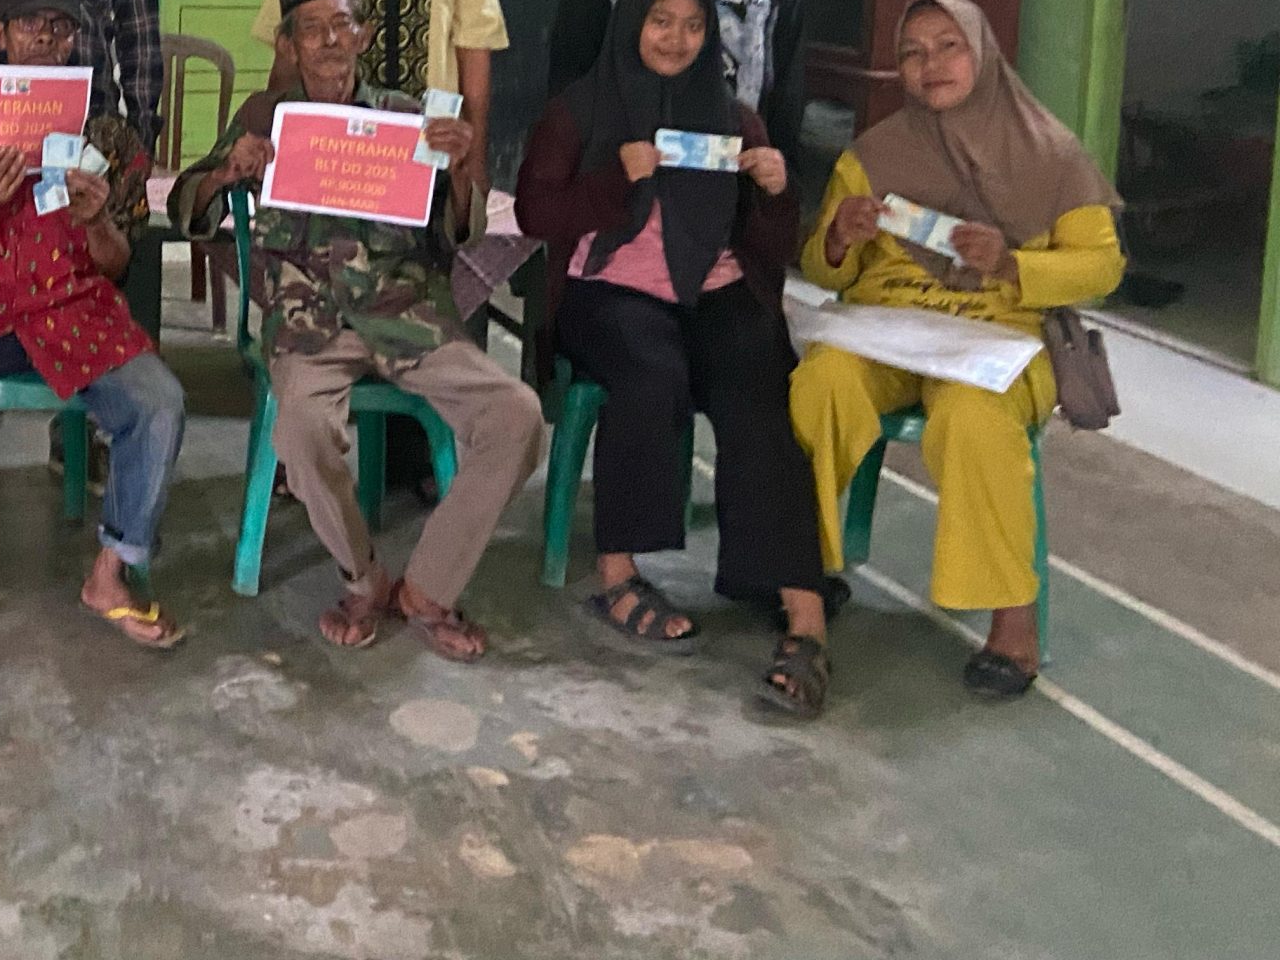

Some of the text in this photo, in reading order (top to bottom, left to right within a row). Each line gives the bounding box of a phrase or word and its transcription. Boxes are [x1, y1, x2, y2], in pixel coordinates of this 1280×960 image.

[309, 137, 409, 162] PENYERAHAN
[314, 158, 398, 181] BLT DD 2025
